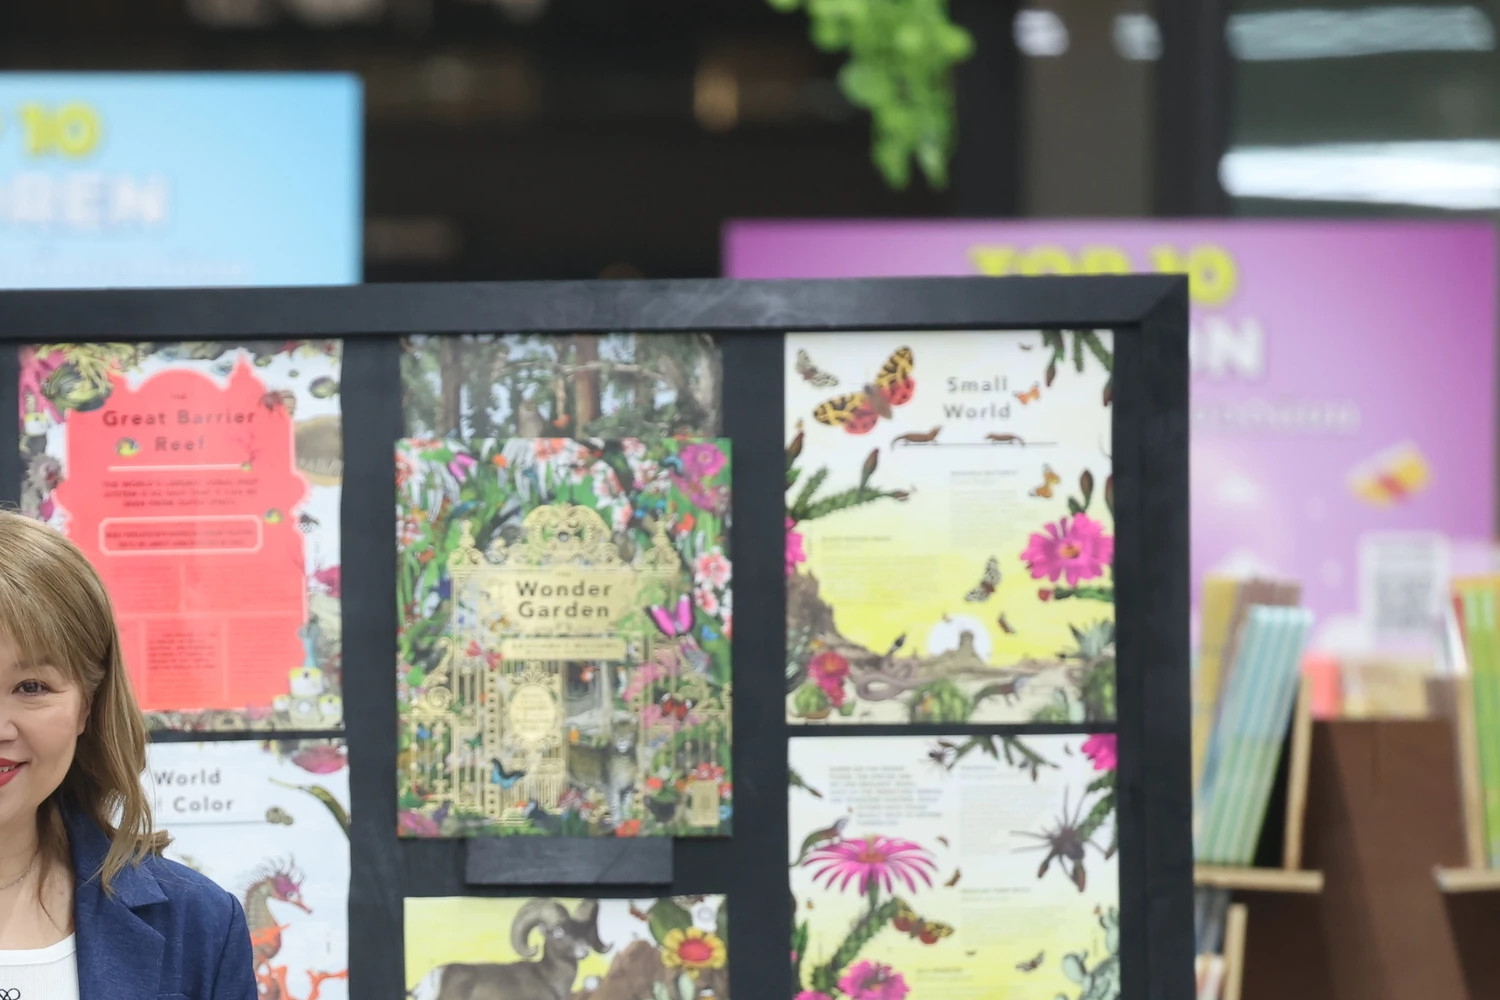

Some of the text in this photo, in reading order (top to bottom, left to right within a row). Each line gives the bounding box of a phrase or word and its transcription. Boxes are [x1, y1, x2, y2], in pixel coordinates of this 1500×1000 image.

[20, 101, 100, 159] 10
[947, 376, 1008, 393] Small
[103, 409, 255, 427] Great Barrier
[943, 403, 1012, 420] World
[155, 435, 205, 451] Reef
[516, 581, 612, 597] Wonder
[518, 601, 609, 618] Garden
[154, 769, 221, 785] World
[173, 797, 234, 812] Color
